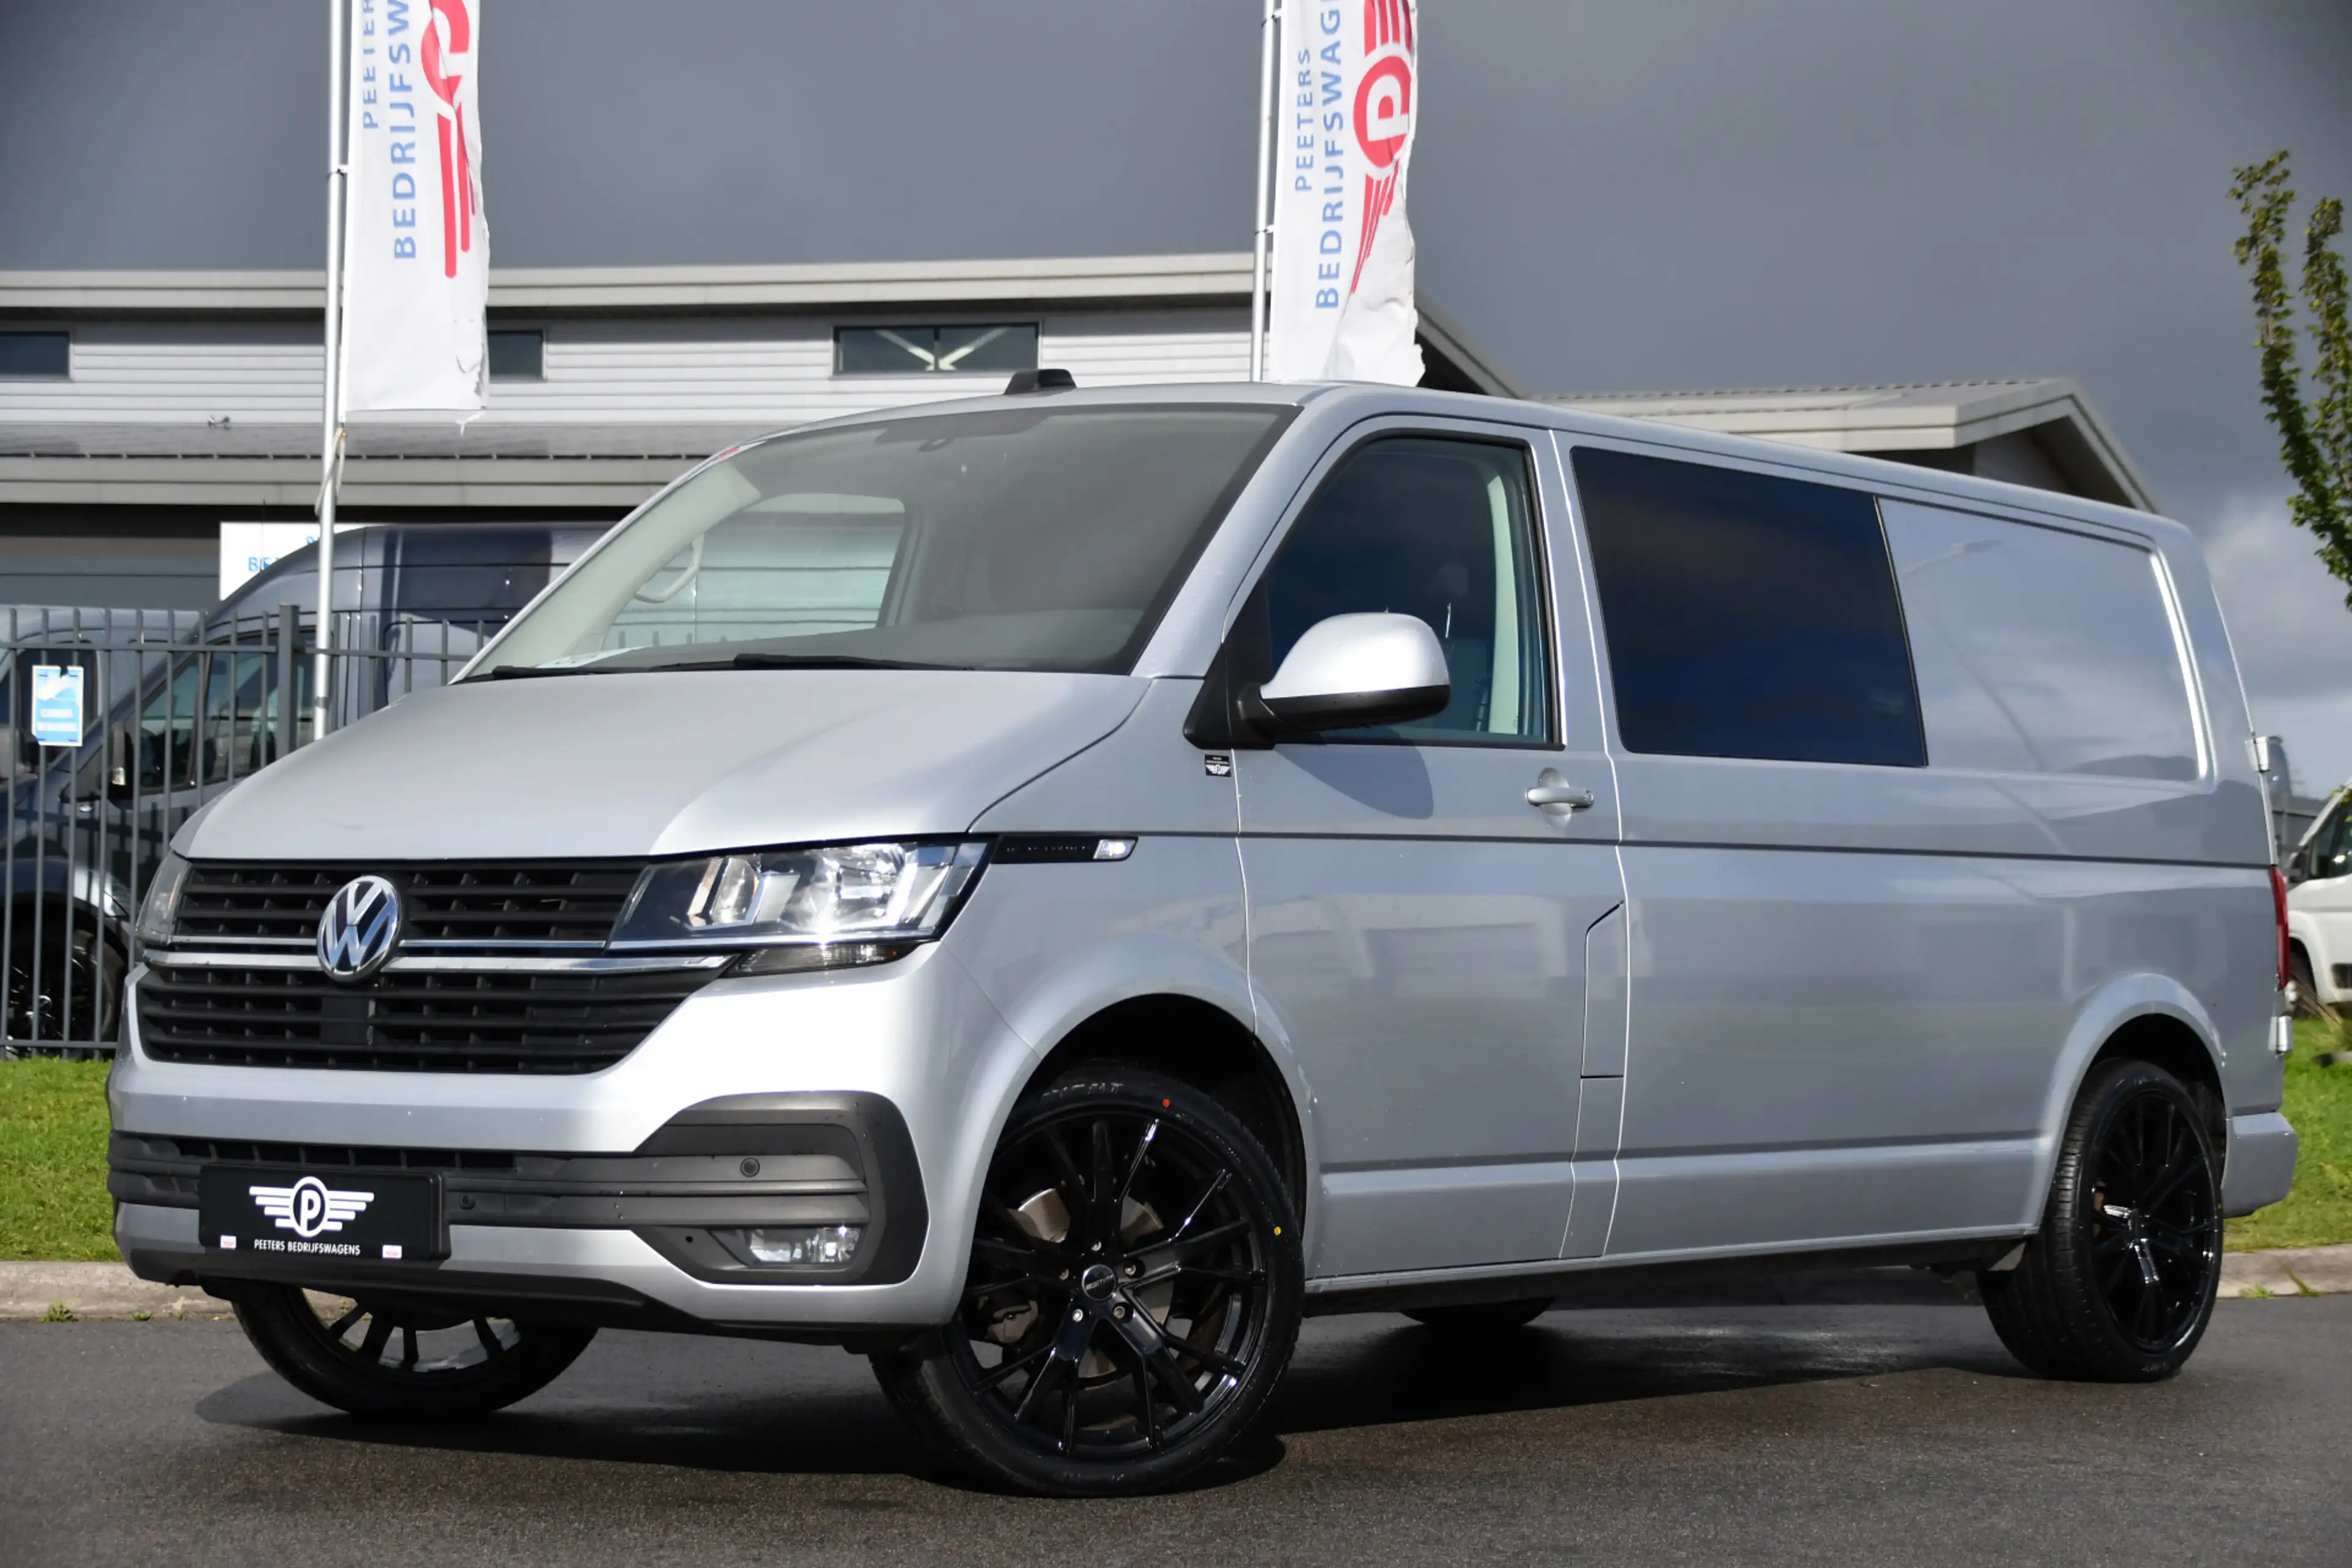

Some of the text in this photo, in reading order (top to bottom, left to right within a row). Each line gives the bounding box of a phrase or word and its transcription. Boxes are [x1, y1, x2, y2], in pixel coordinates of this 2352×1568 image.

[1294, 49, 1314, 192] PEETERS
[1315, 0, 1344, 308] BEDRIJFSWAG
[254, 1238, 361, 1256] PEETERS BEDRIJFSWAGENS
